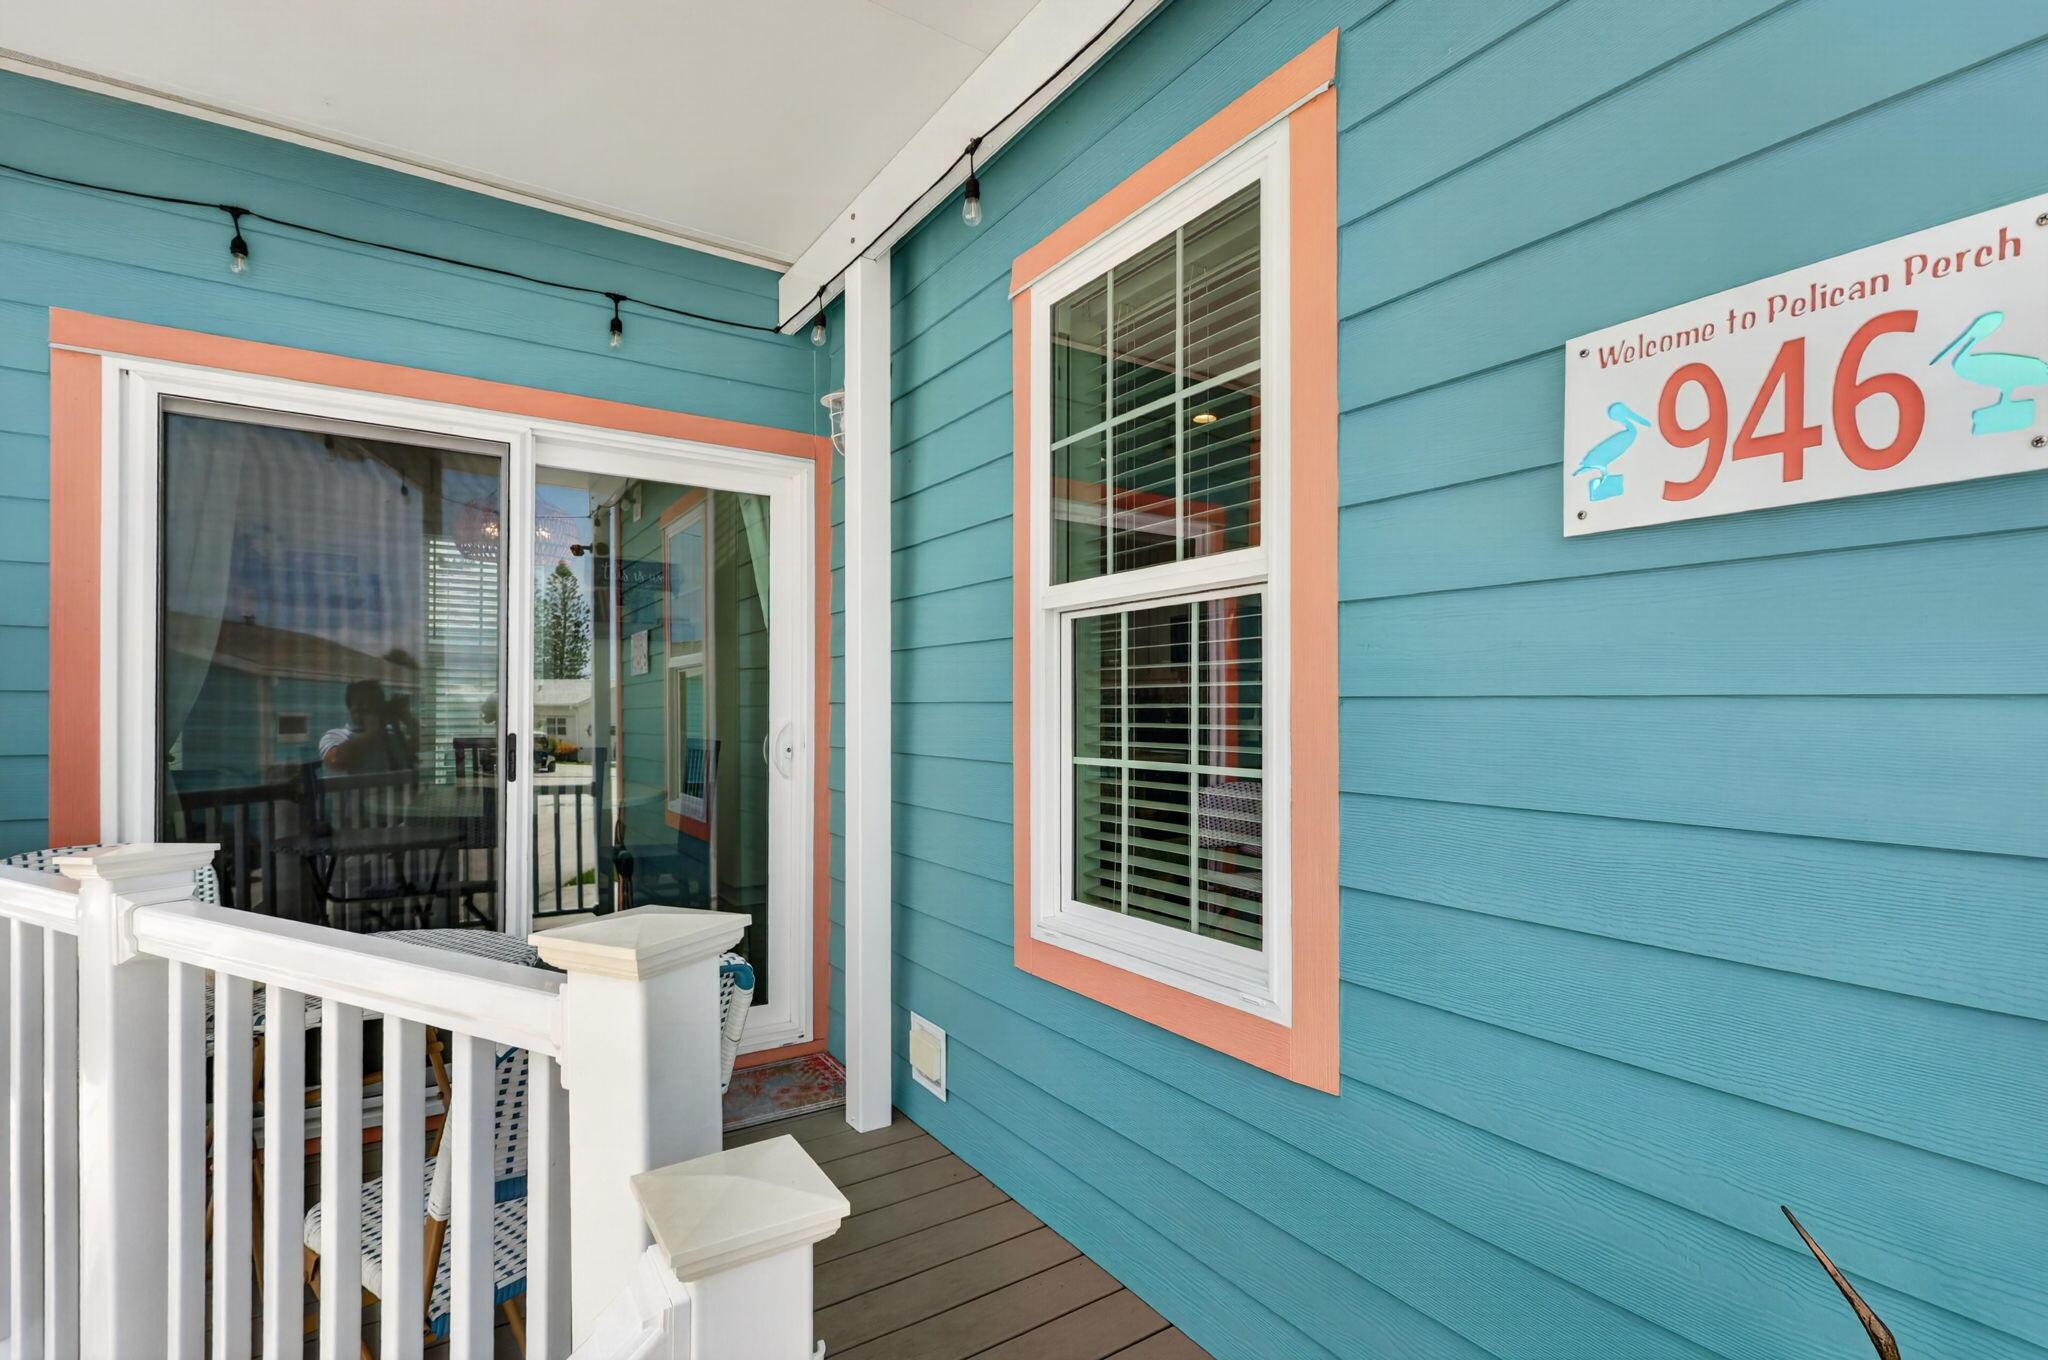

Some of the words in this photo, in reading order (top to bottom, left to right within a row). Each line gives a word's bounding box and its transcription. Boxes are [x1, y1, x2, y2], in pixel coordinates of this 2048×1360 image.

[1598, 323, 1715, 369] Welcome
[1729, 308, 1756, 334] to
[1768, 273, 1890, 322] Pelican
[1904, 226, 2022, 287] Perch
[1657, 308, 1926, 503] 946
